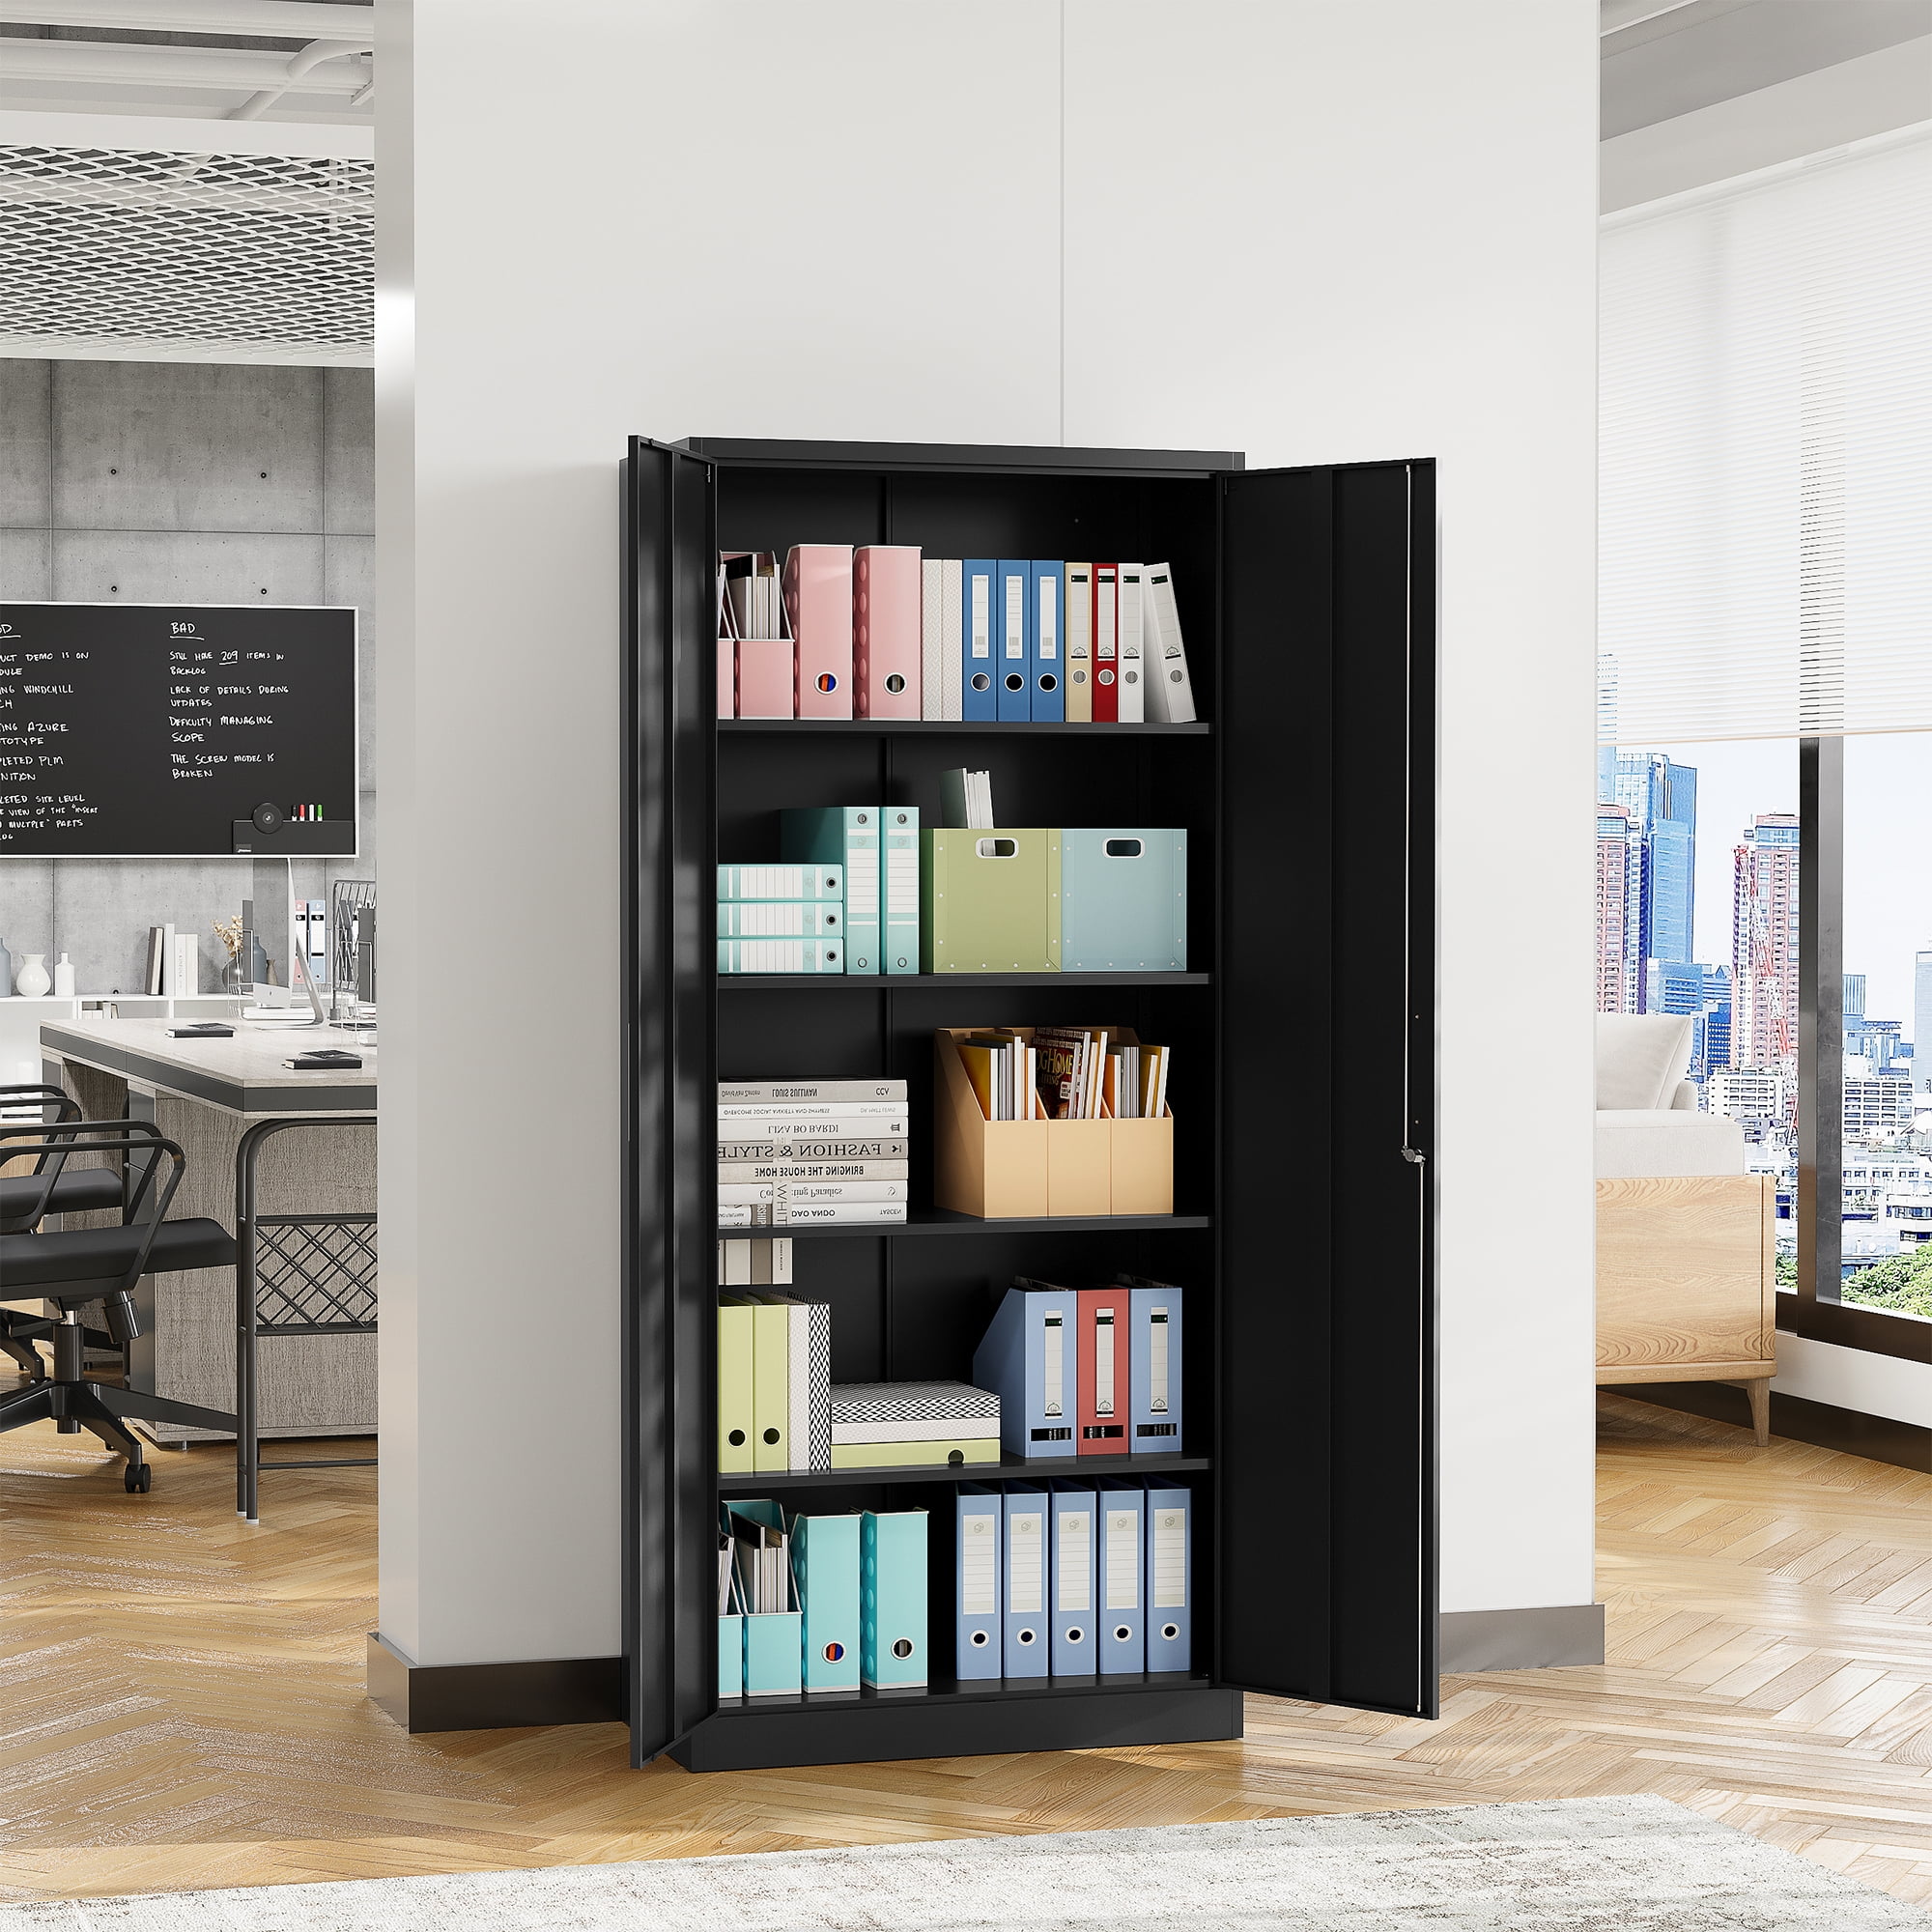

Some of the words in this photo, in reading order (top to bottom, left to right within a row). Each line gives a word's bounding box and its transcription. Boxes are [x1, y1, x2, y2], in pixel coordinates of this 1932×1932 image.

[170, 622, 196, 634] BAD
[0, 654, 17, 663] UCT
[25, 653, 53, 662] DEMO
[220, 650, 239, 662] 209
[246, 651, 270, 660] ITEMS
[0, 668, 23, 676] DULE
[170, 666, 207, 675] BACKLOG
[0, 685, 15, 695] NG
[23, 684, 74, 695] WINDCHILL
[170, 686, 192, 695] LACK
[217, 685, 252, 696] DETAILS
[170, 698, 213, 707] UPDATES
[219, 715, 273, 725] MANAGING
[0, 723, 18, 732] ING
[27, 722, 70, 732] AZURE
[0, 737, 44, 746] TOTYPE
[171, 732, 205, 742] SCOPE
[0, 756, 34, 766] LETED
[39, 756, 64, 766] PLM
[171, 753, 189, 764] THE
[195, 753, 228, 764] SCREW
[268, 753, 274, 762] IS
[0, 773, 37, 781] NITION
[172, 769, 213, 780] BROKEN
[0, 795, 28, 804] LETED
[58, 794, 85, 804] LEVEL
[36, 807, 45, 815] OF
[56, 819, 84, 829] PARTS
[777, 1183, 787, 1225] WHIT
[757, 1204, 767, 1225] RSHIP
